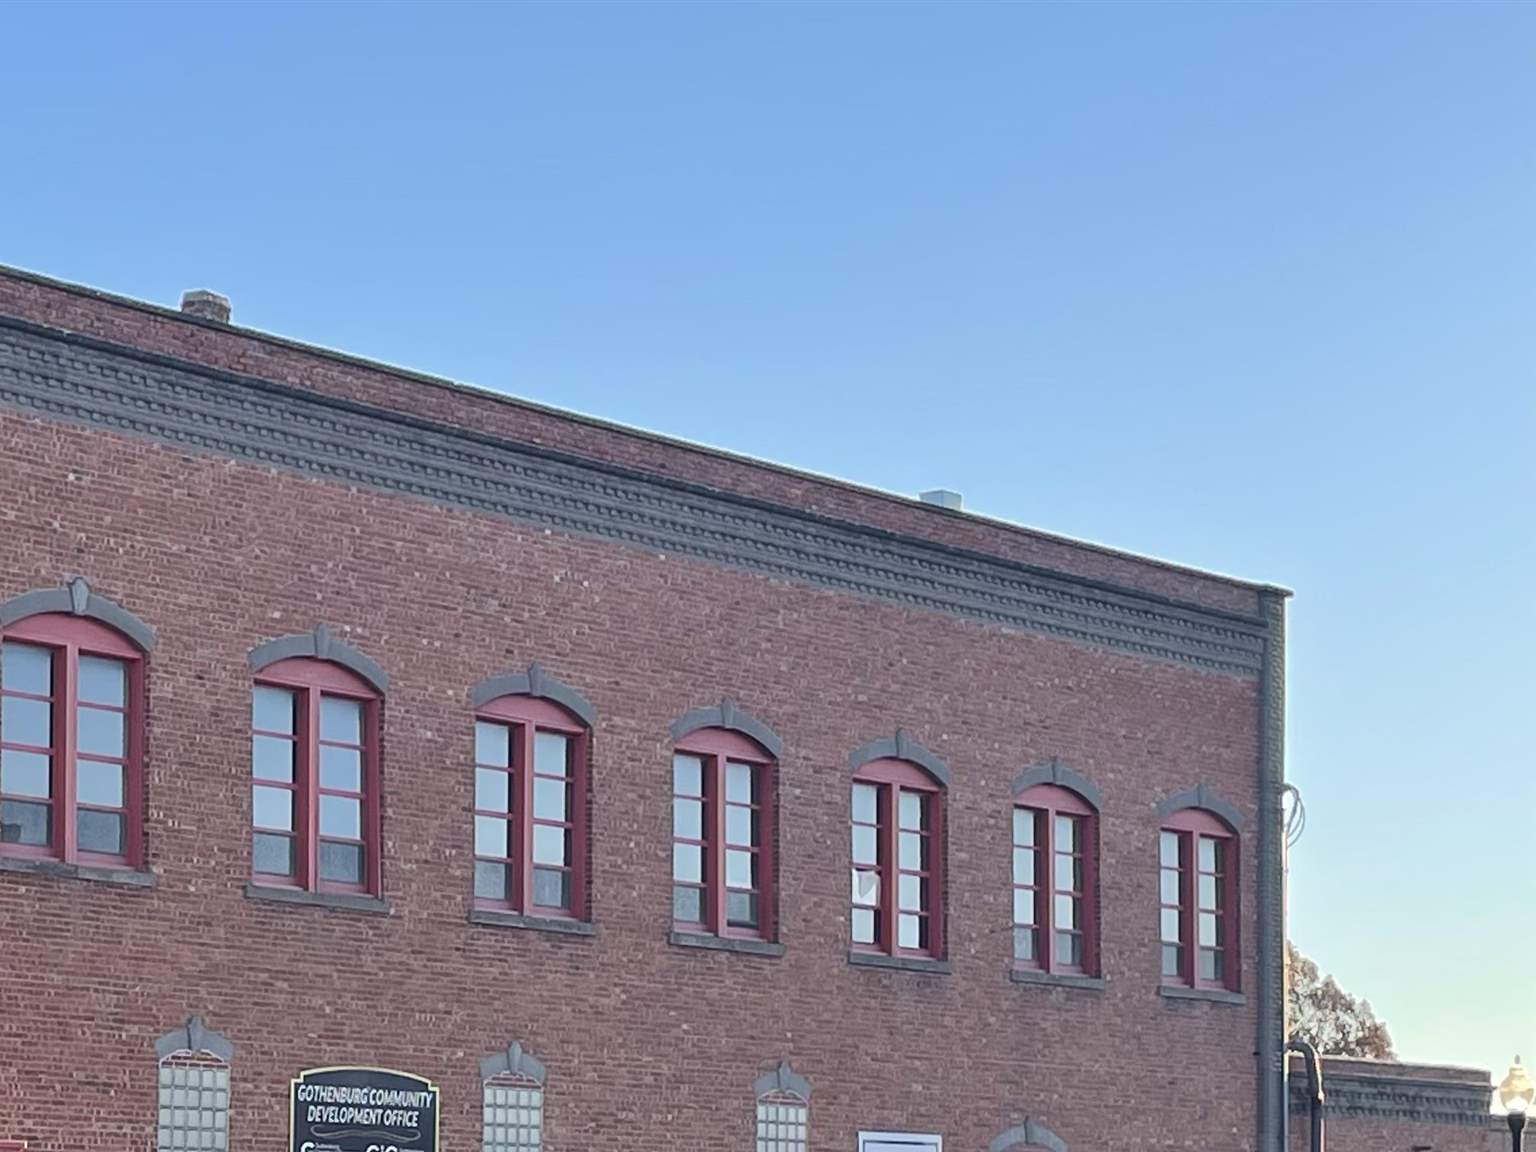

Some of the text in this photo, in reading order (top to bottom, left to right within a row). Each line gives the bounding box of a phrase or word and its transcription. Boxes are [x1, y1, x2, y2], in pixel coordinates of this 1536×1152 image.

[297, 1085, 433, 1108] GOTHENBURG COMMUNITY
[307, 1105, 419, 1127] DEVELOPMENT OFFICE
